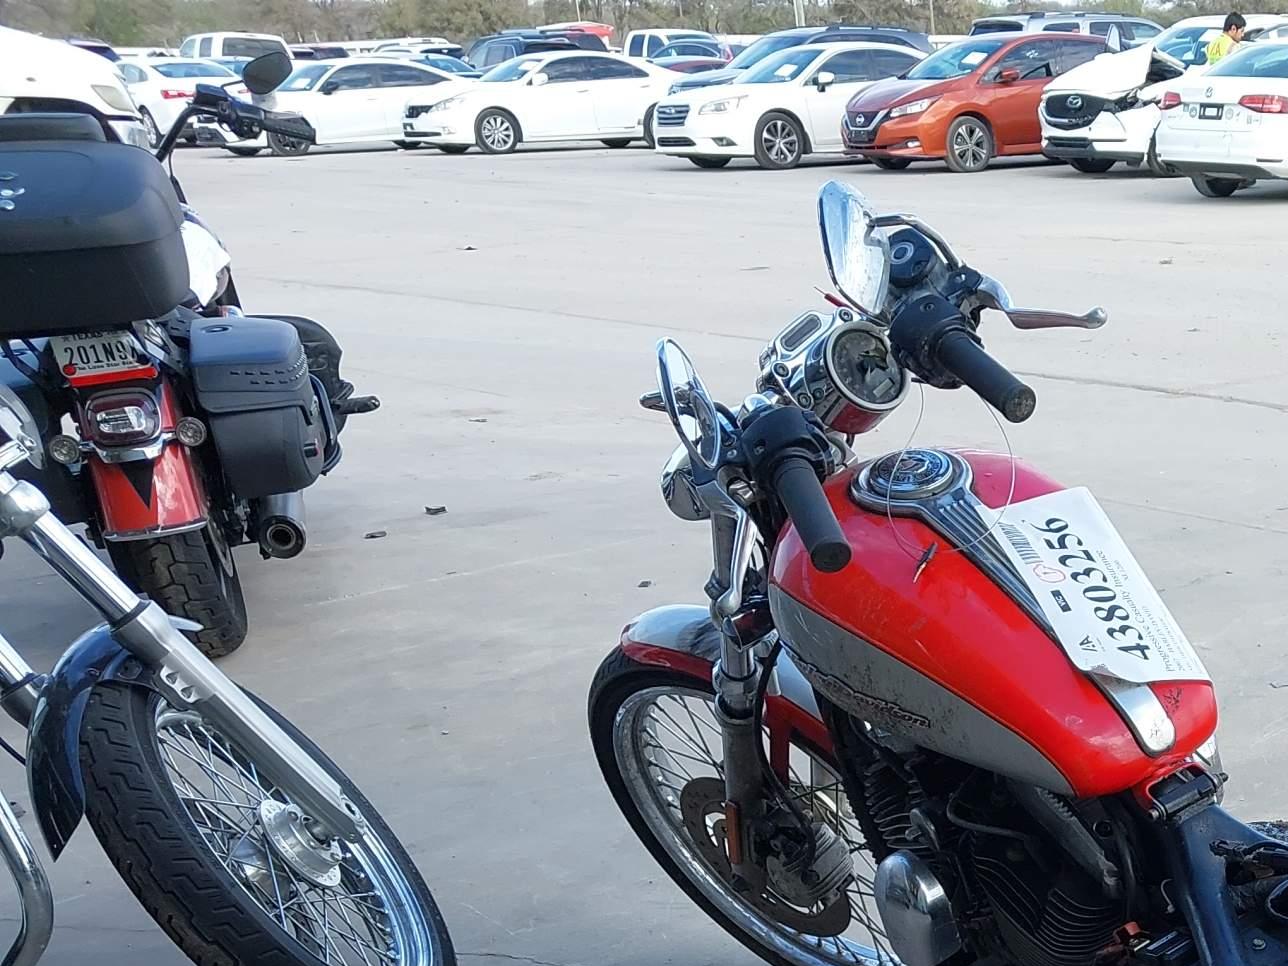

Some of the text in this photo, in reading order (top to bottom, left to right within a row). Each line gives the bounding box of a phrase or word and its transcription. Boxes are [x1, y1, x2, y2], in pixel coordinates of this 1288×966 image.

[1030, 517, 1151, 660] 43803256
[1096, 550, 1123, 588] Insurance
[1120, 590, 1145, 624] Casualty
[1142, 625, 1176, 672] Progressive
